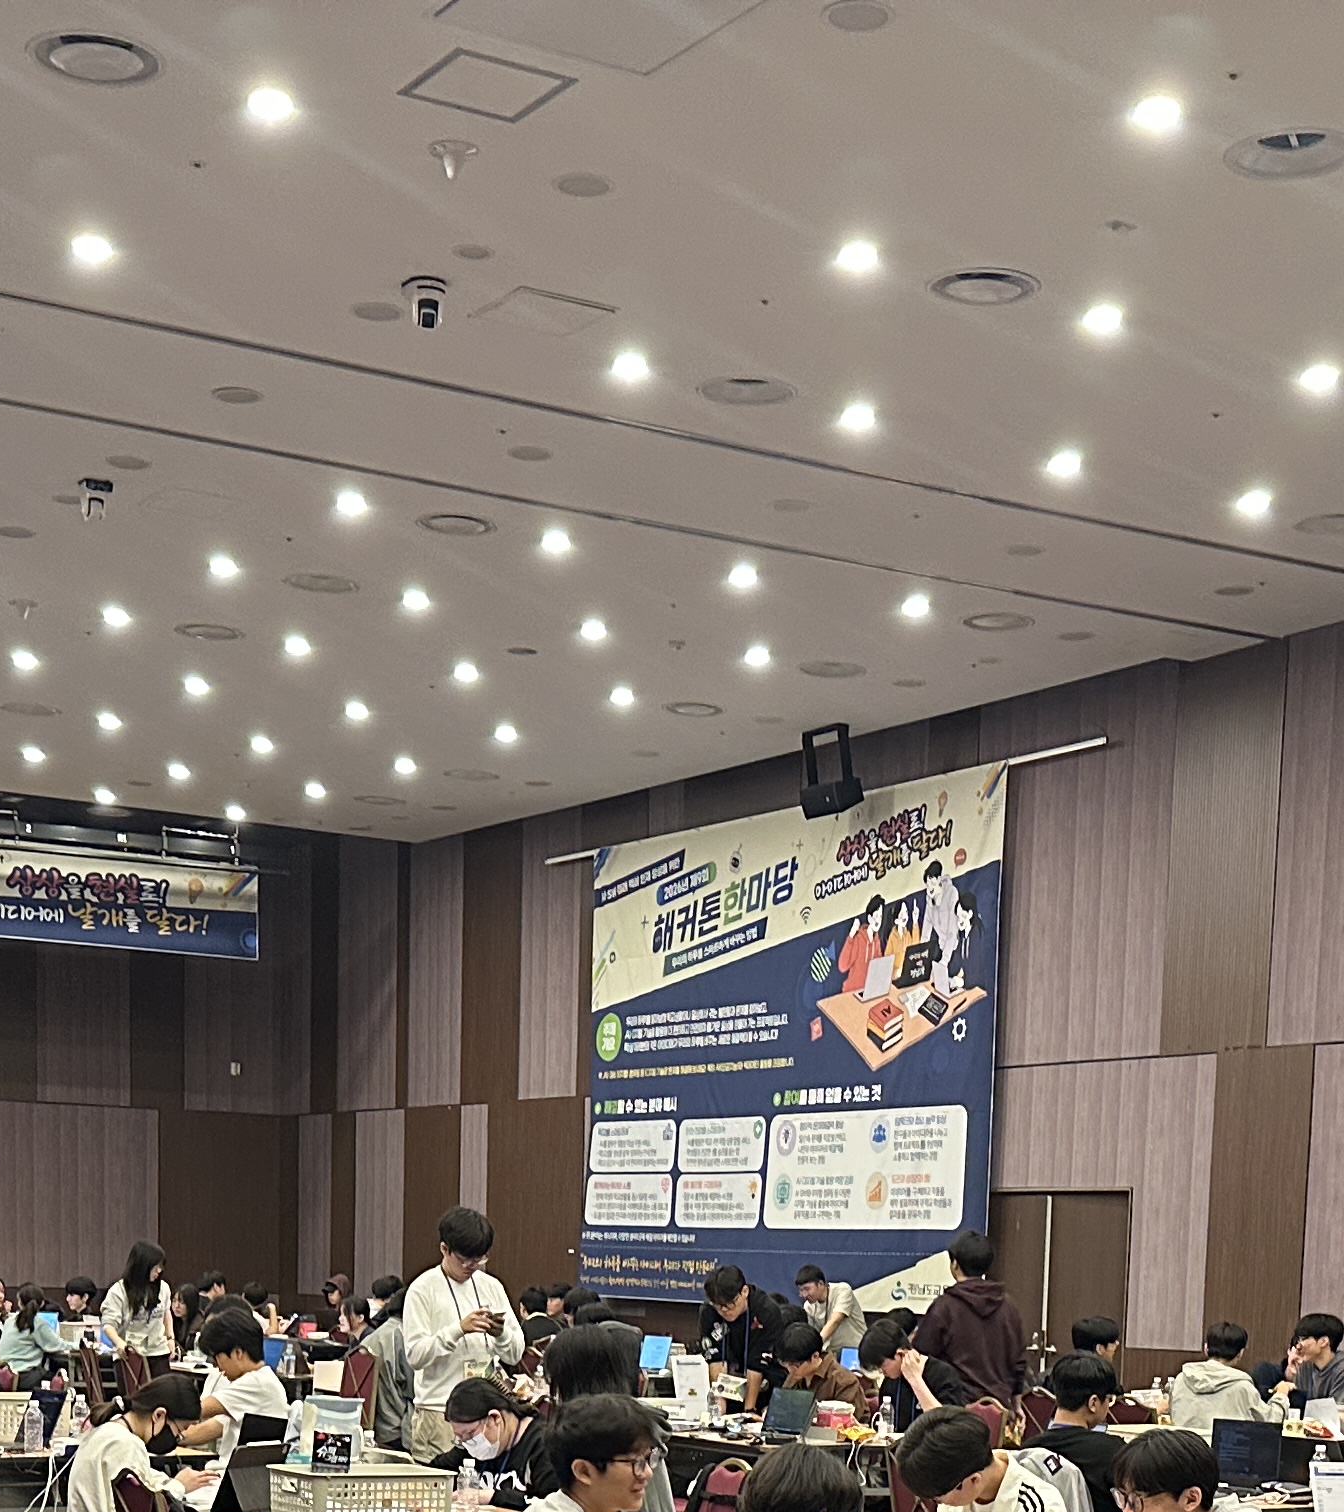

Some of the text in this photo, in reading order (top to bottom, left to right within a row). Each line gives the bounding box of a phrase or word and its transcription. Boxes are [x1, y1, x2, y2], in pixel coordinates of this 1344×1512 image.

[6, 864, 170, 906] 상상을 현실로!
[67, 902, 142, 933] 날개를
[144, 906, 210, 937] 달다!
